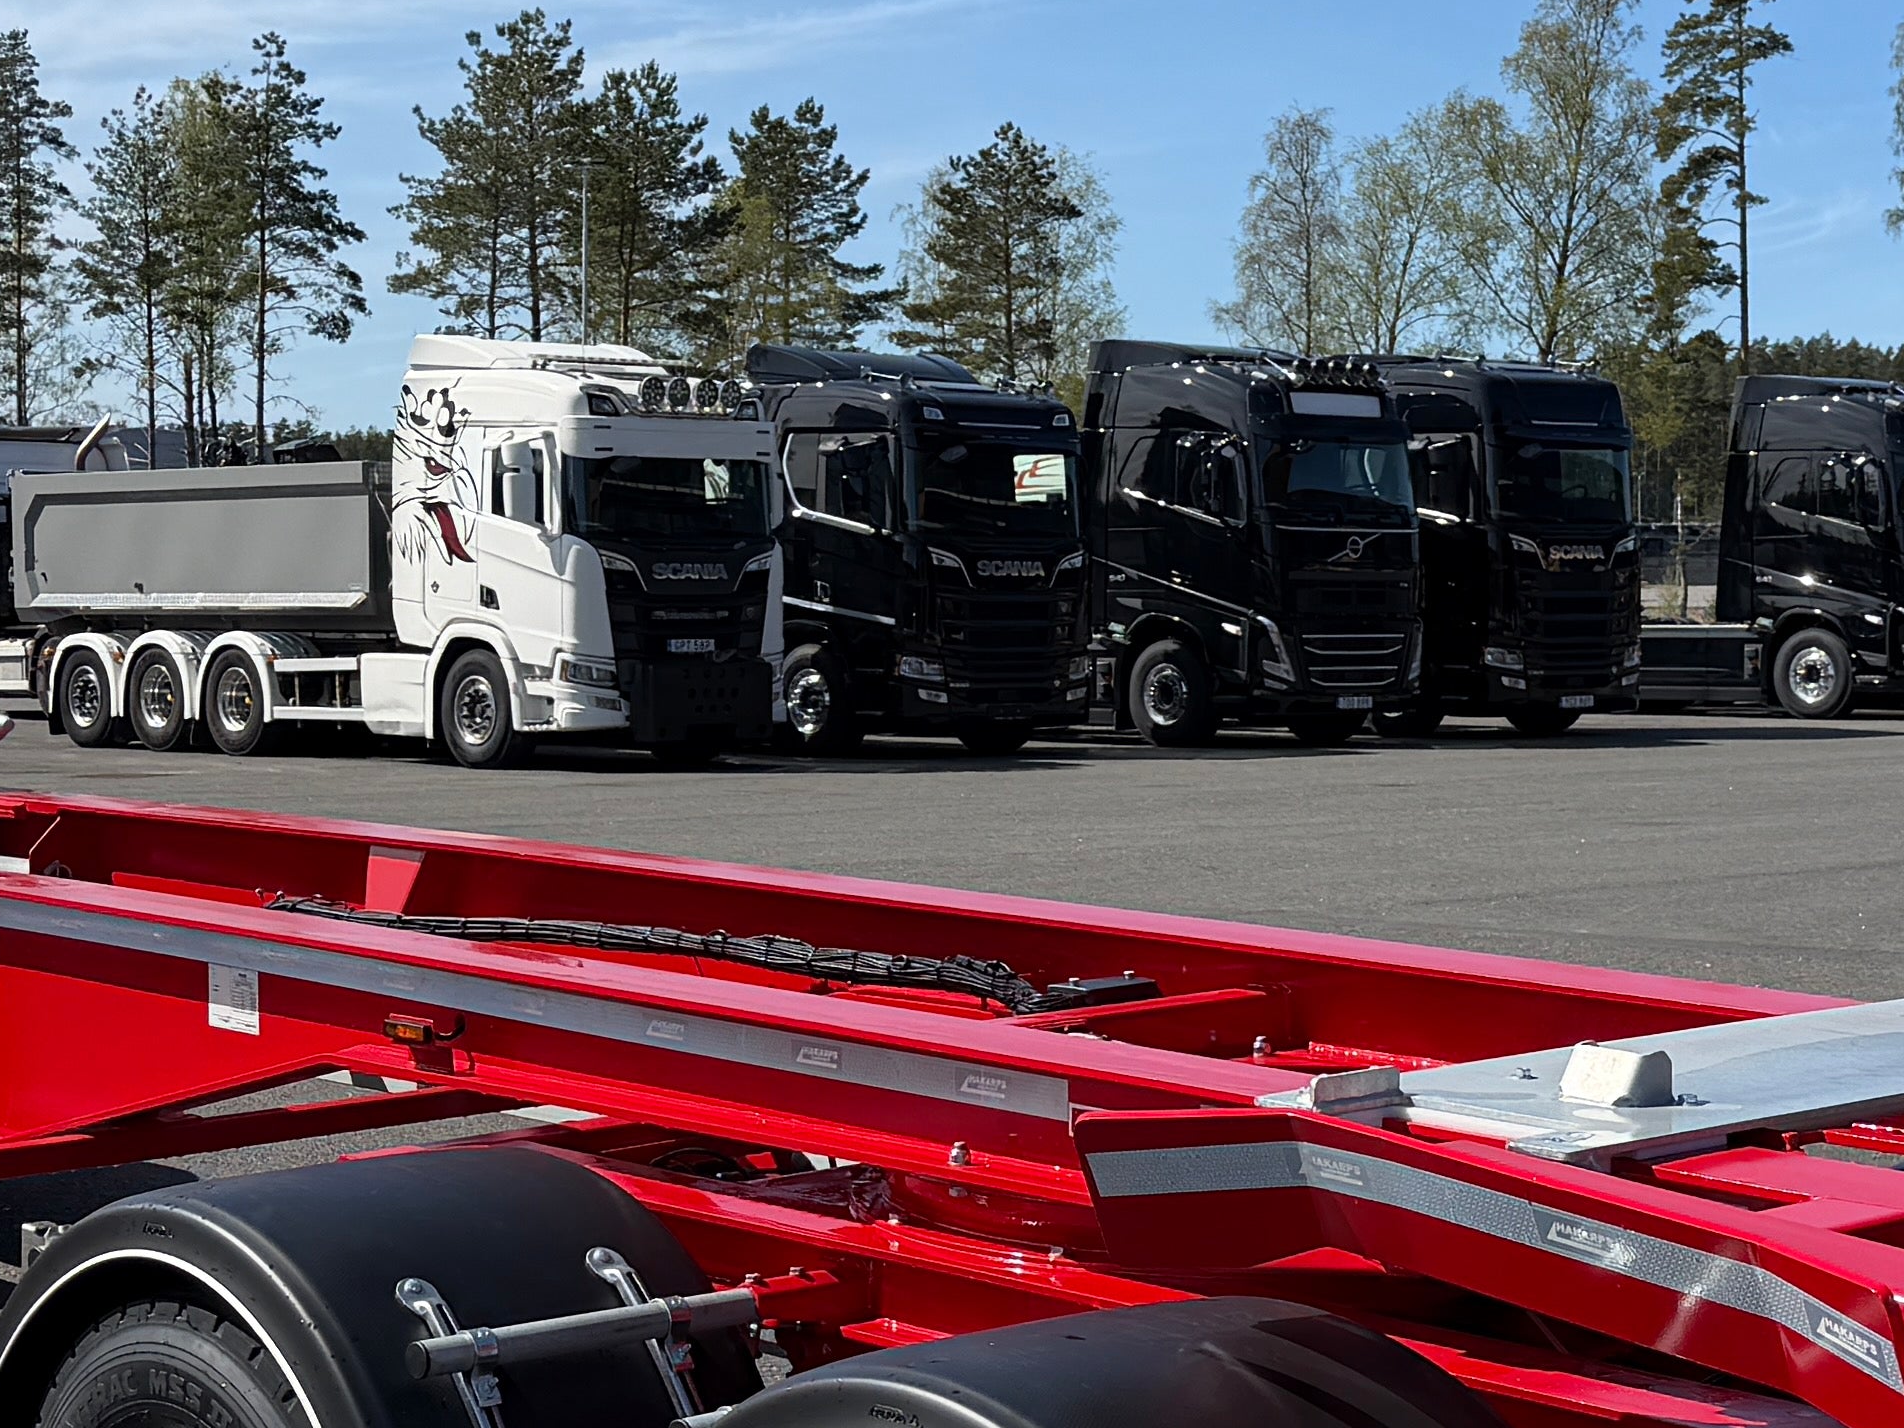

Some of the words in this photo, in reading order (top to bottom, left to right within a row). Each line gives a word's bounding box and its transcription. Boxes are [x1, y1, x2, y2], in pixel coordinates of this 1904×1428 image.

[1550, 544, 1605, 560] SCANIA
[652, 562, 729, 580] SCANIA
[977, 559, 1045, 577] SCANIA
[1824, 1316, 1878, 1356] HAKARPS
